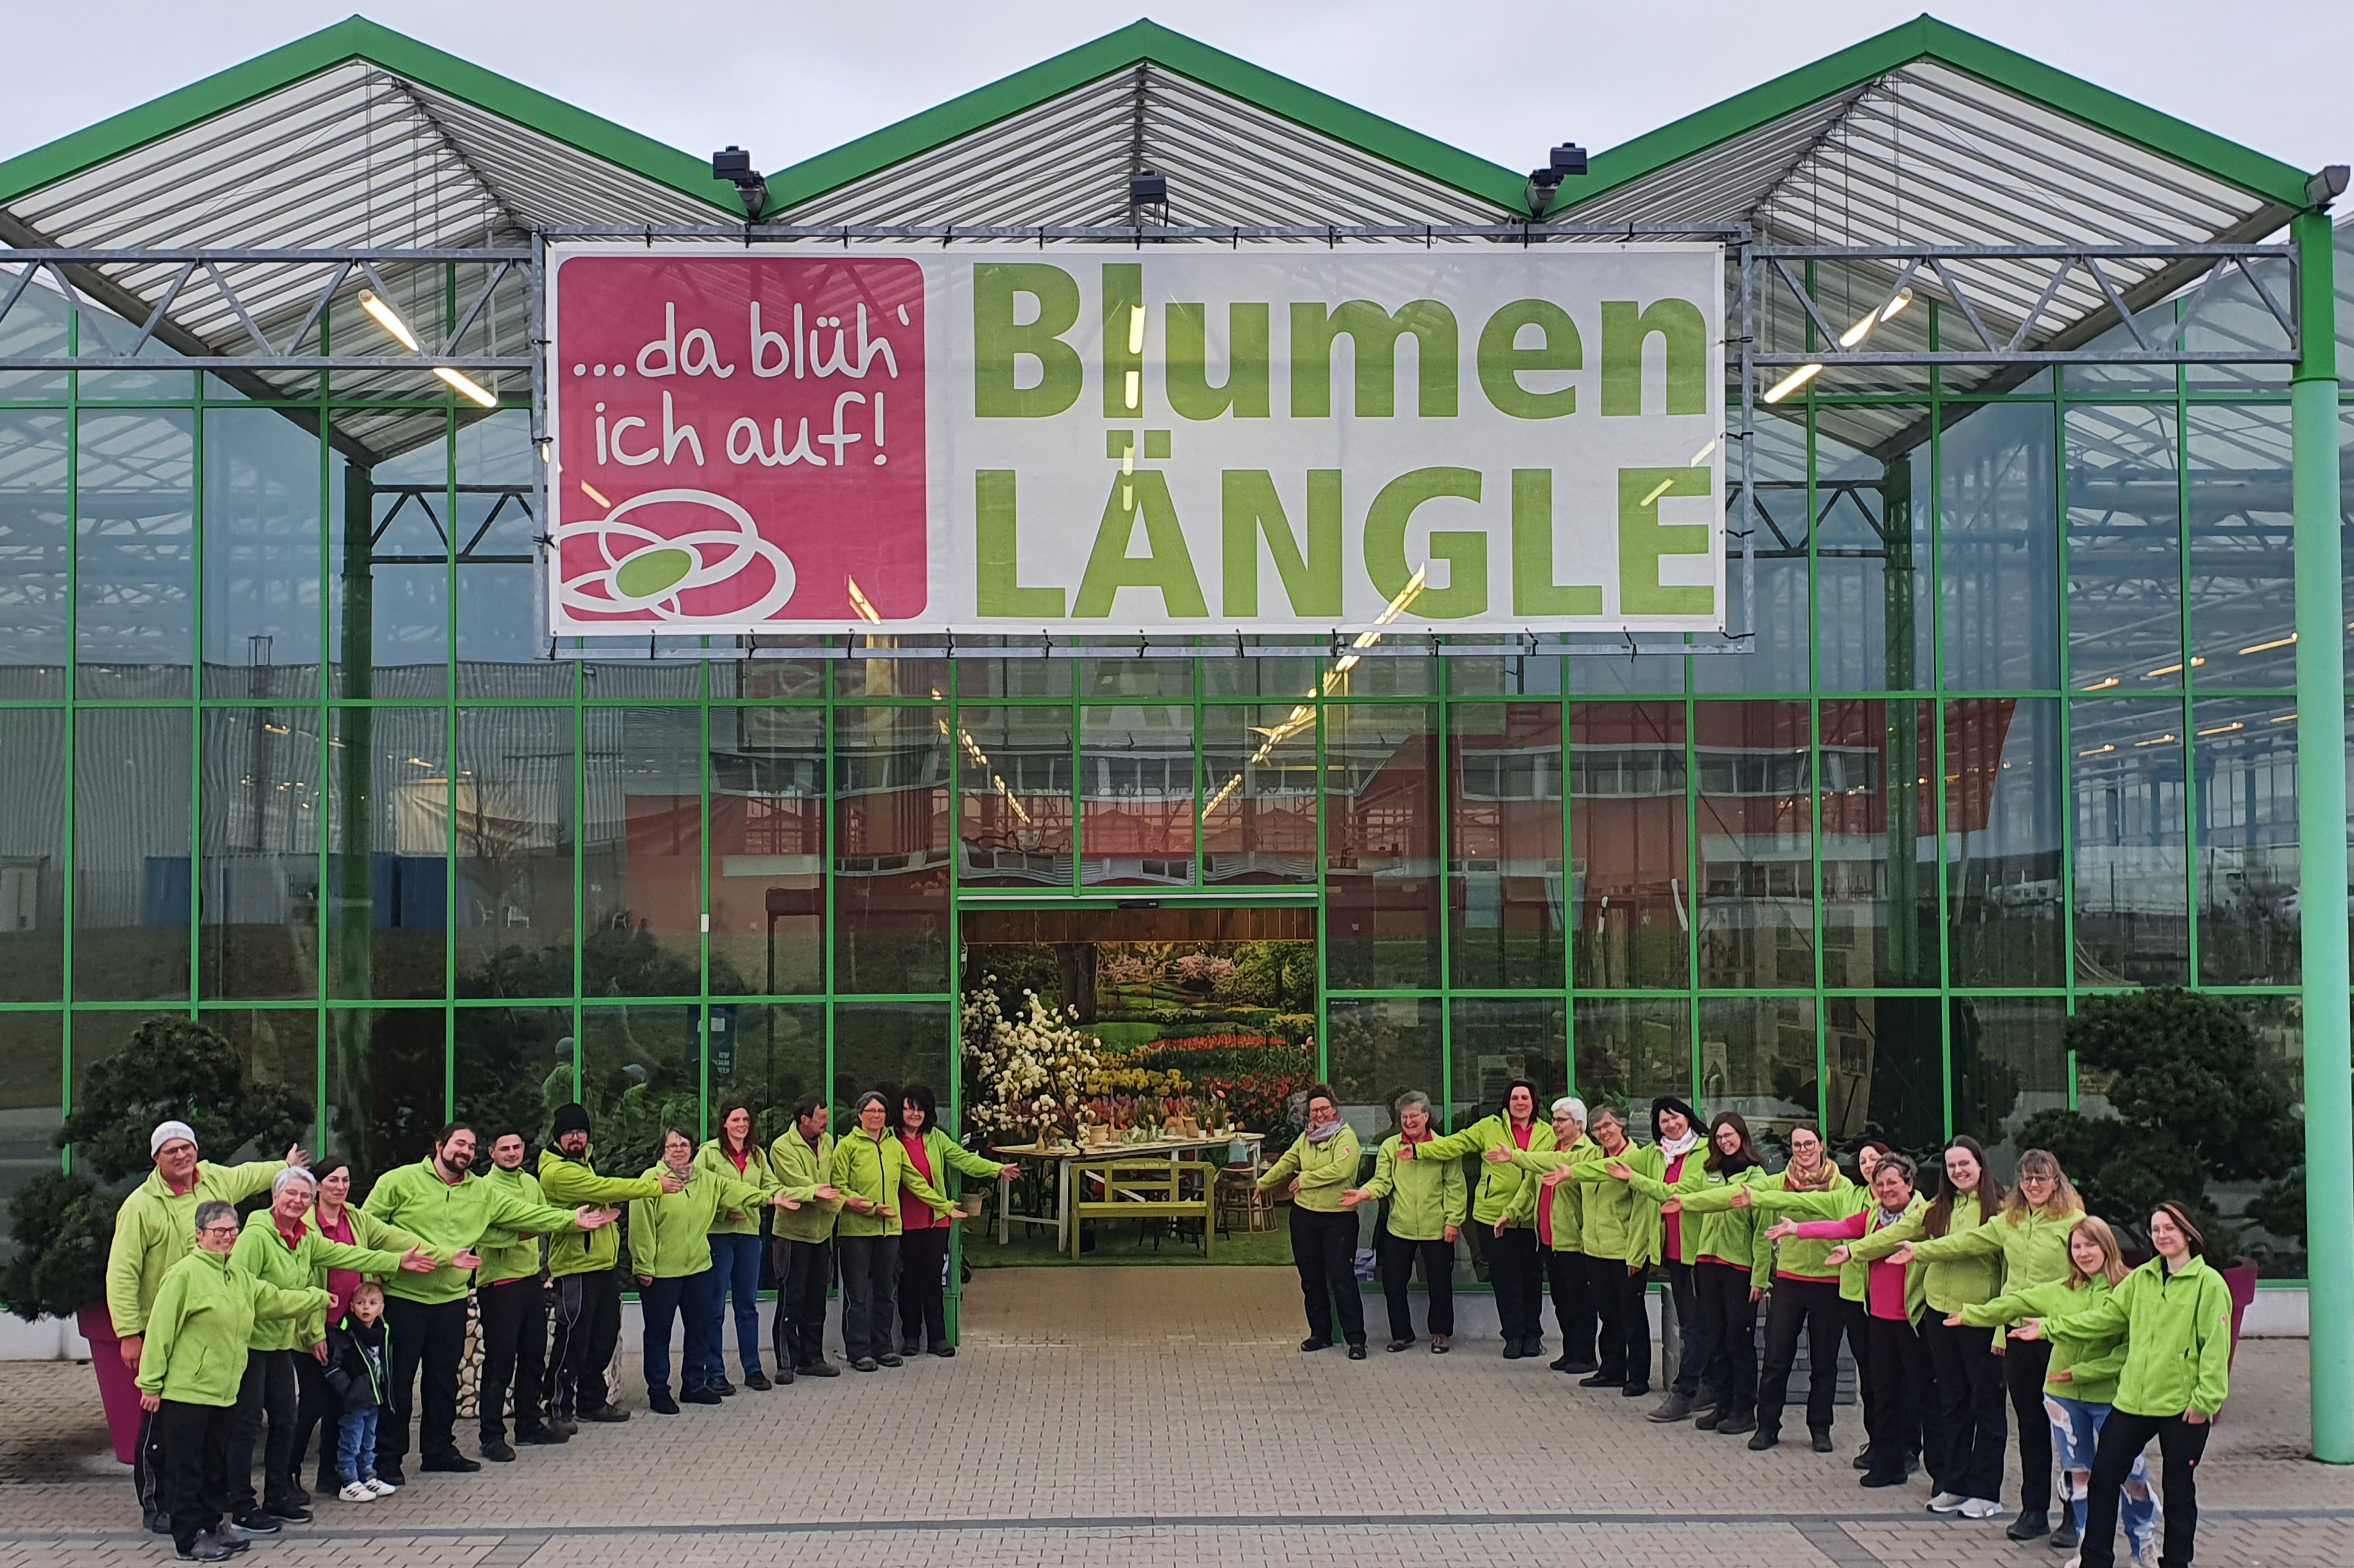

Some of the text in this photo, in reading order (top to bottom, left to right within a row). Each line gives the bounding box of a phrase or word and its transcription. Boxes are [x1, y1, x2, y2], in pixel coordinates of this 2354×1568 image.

[975, 264, 1706, 420] Blumen
[595, 390, 887, 467] ich auf!
[977, 430, 1715, 619] LÄNGLE
